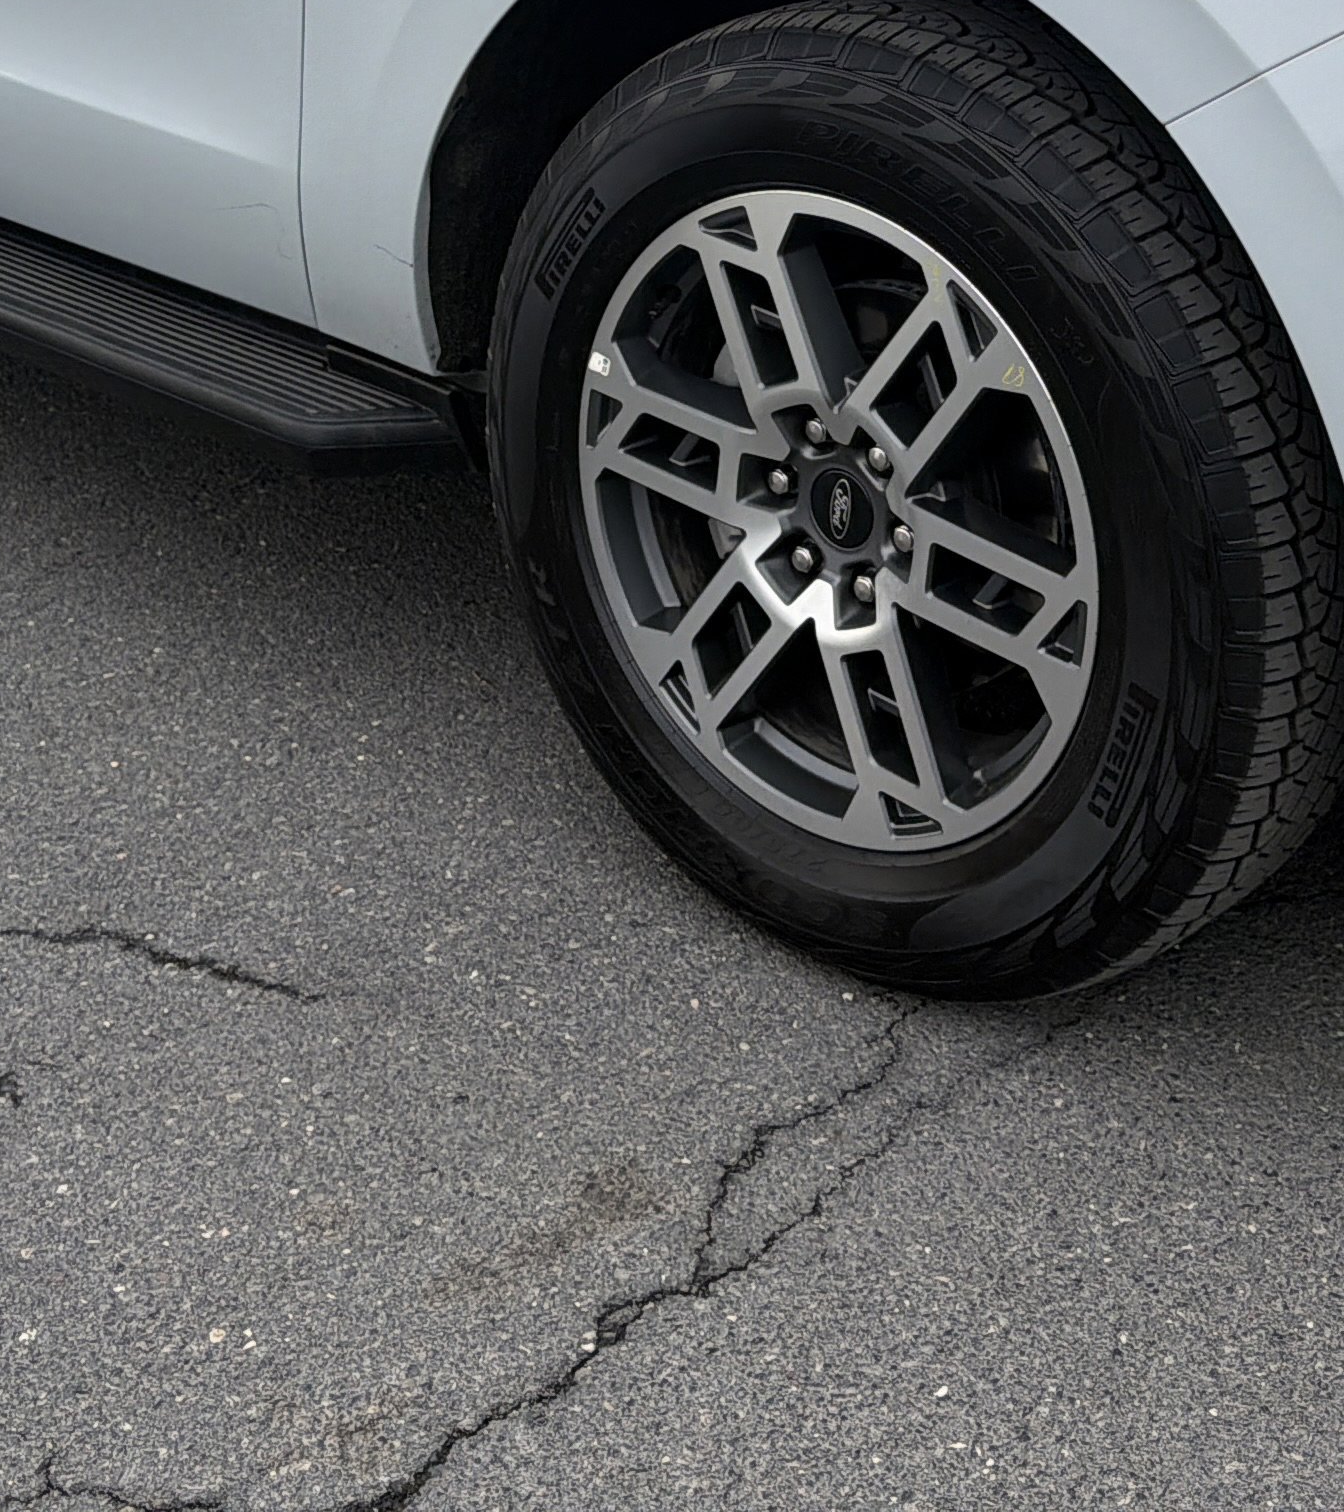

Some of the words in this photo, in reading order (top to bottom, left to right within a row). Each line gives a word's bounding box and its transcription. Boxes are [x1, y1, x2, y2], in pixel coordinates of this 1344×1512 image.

[533, 187, 606, 301] PIRELLI
[831, 485, 850, 533] Ford
[1087, 682, 1160, 828] PIRELLI
